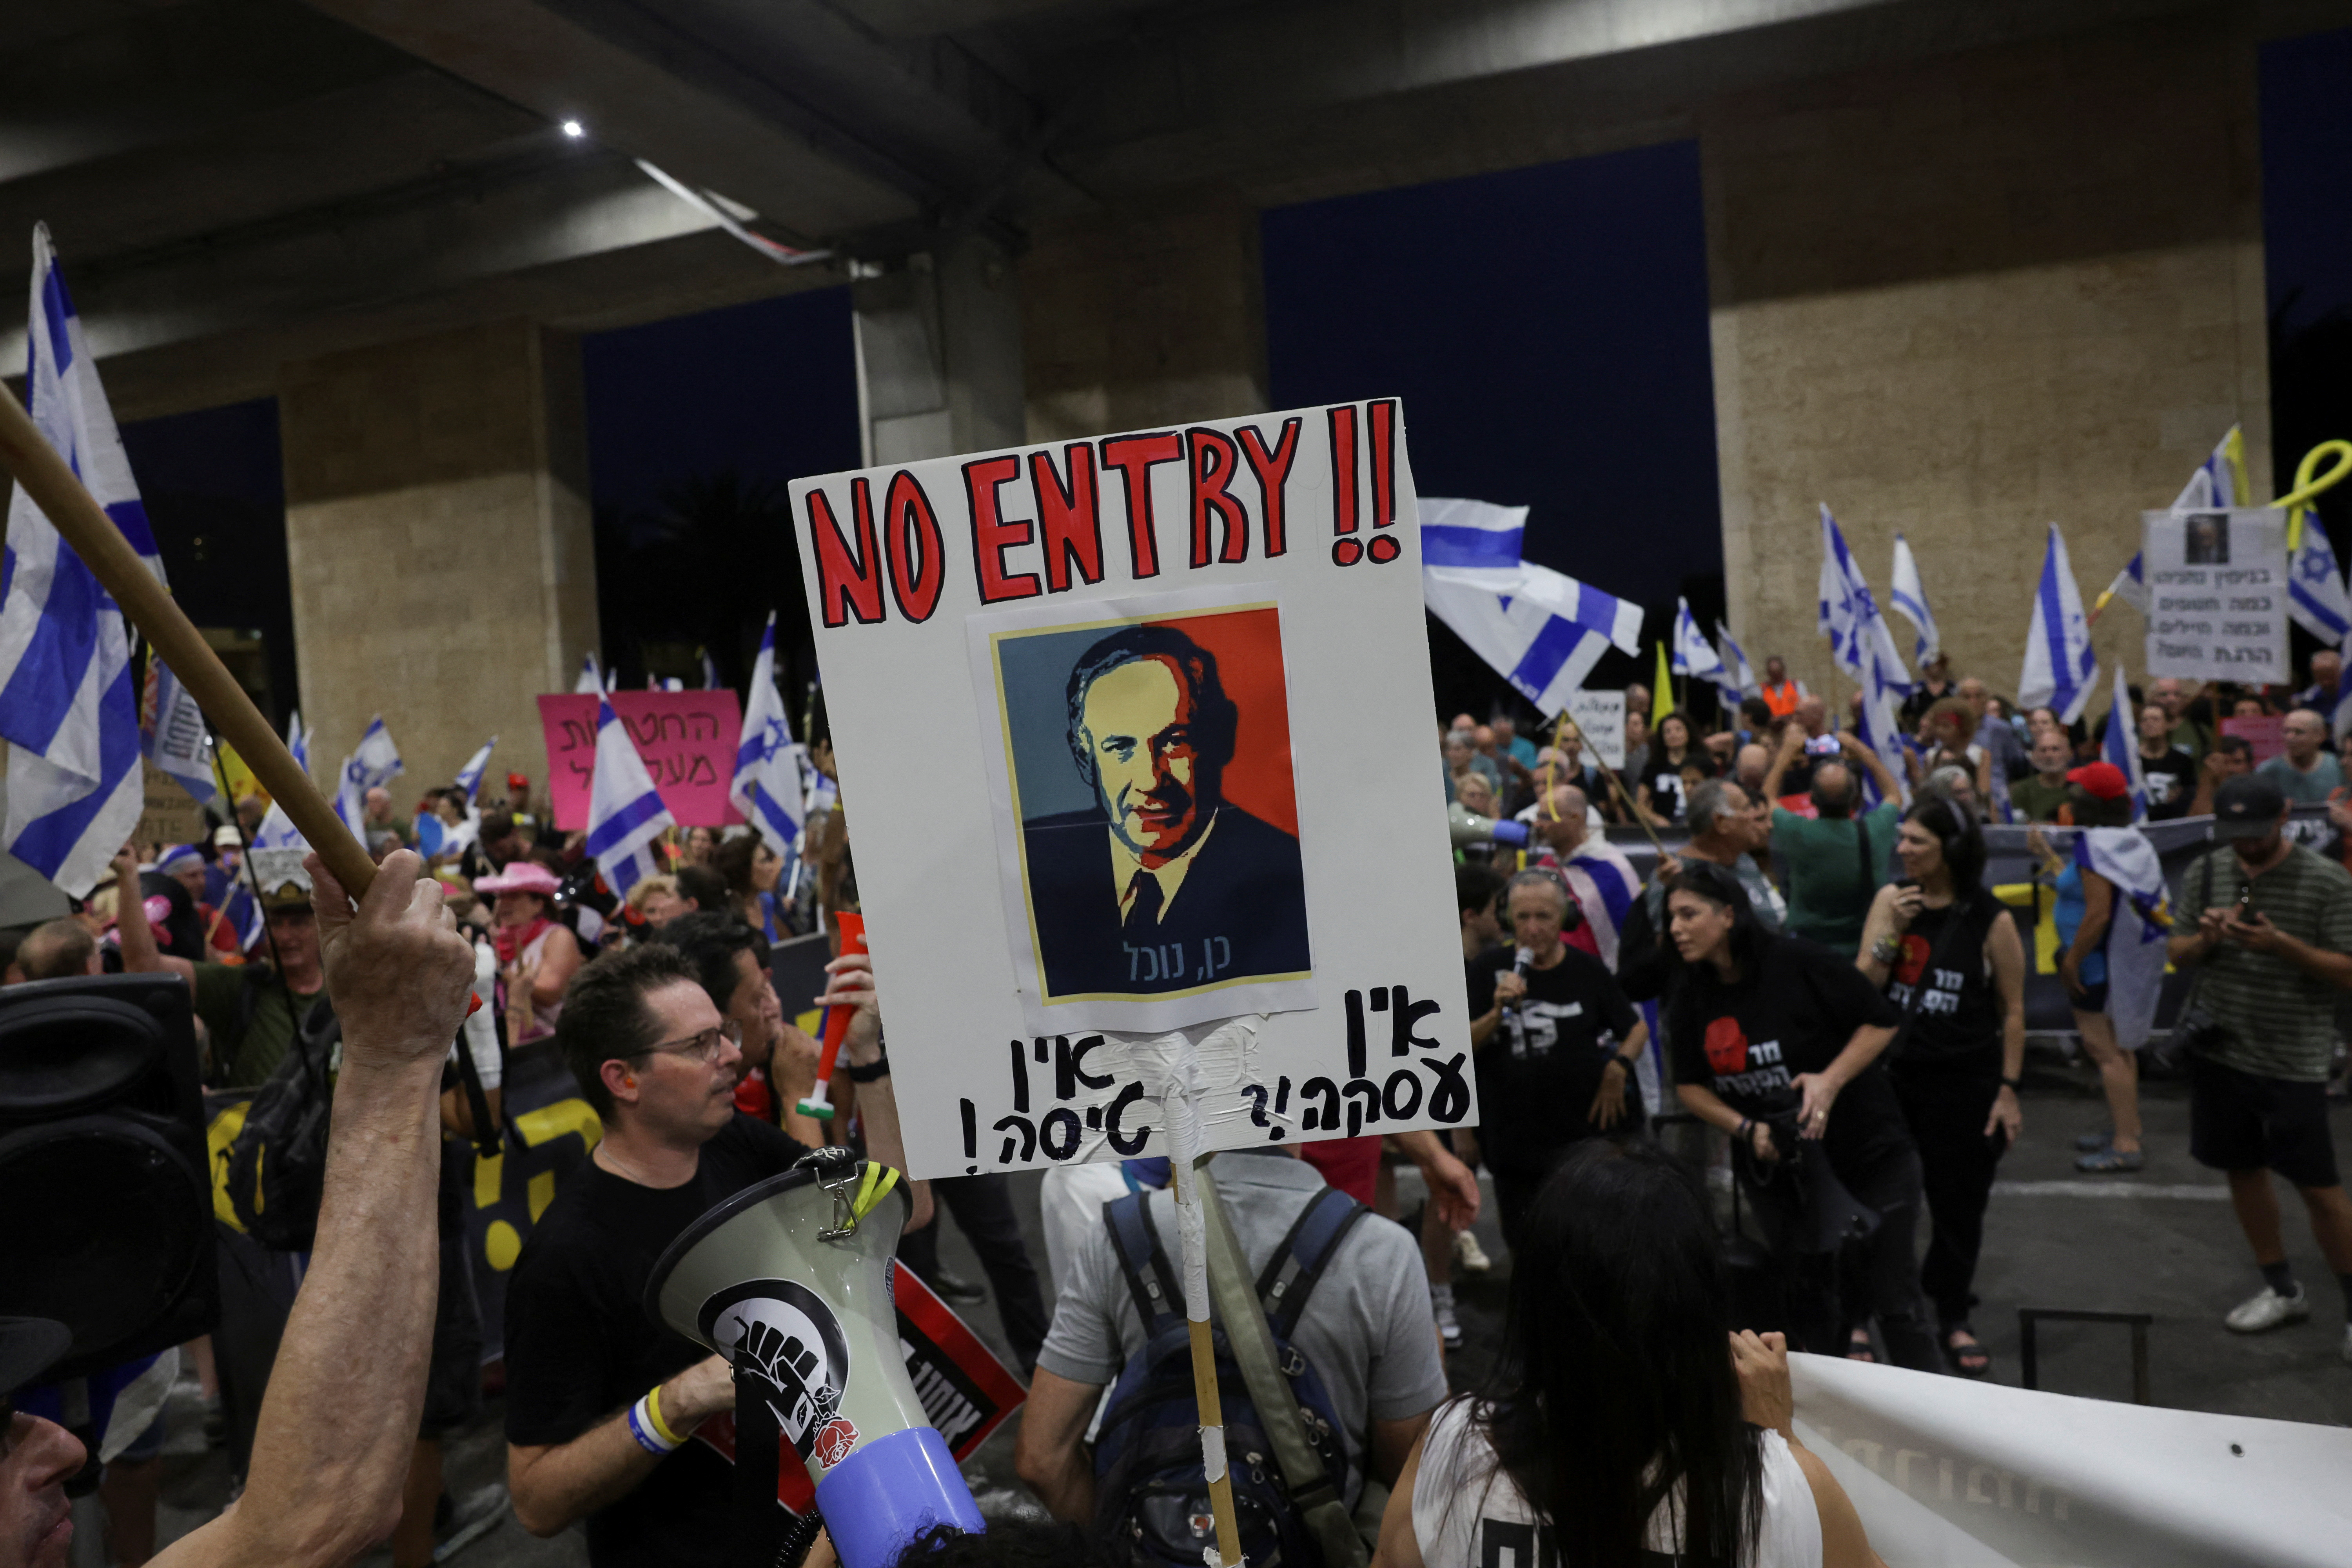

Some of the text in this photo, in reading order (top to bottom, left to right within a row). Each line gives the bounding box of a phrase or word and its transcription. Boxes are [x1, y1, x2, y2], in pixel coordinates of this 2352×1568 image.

[806, 399, 1401, 628] NO ENTRY !!
[561, 710, 720, 751] החטות
[1122, 935, 1231, 981] כן, נוכל
[1345, 984, 1441, 1079] אין
[1010, 1034, 1116, 1114] אין
[960, 1081, 1152, 1175] טיסה!
[886, 1278, 895, 1303] PEAK
